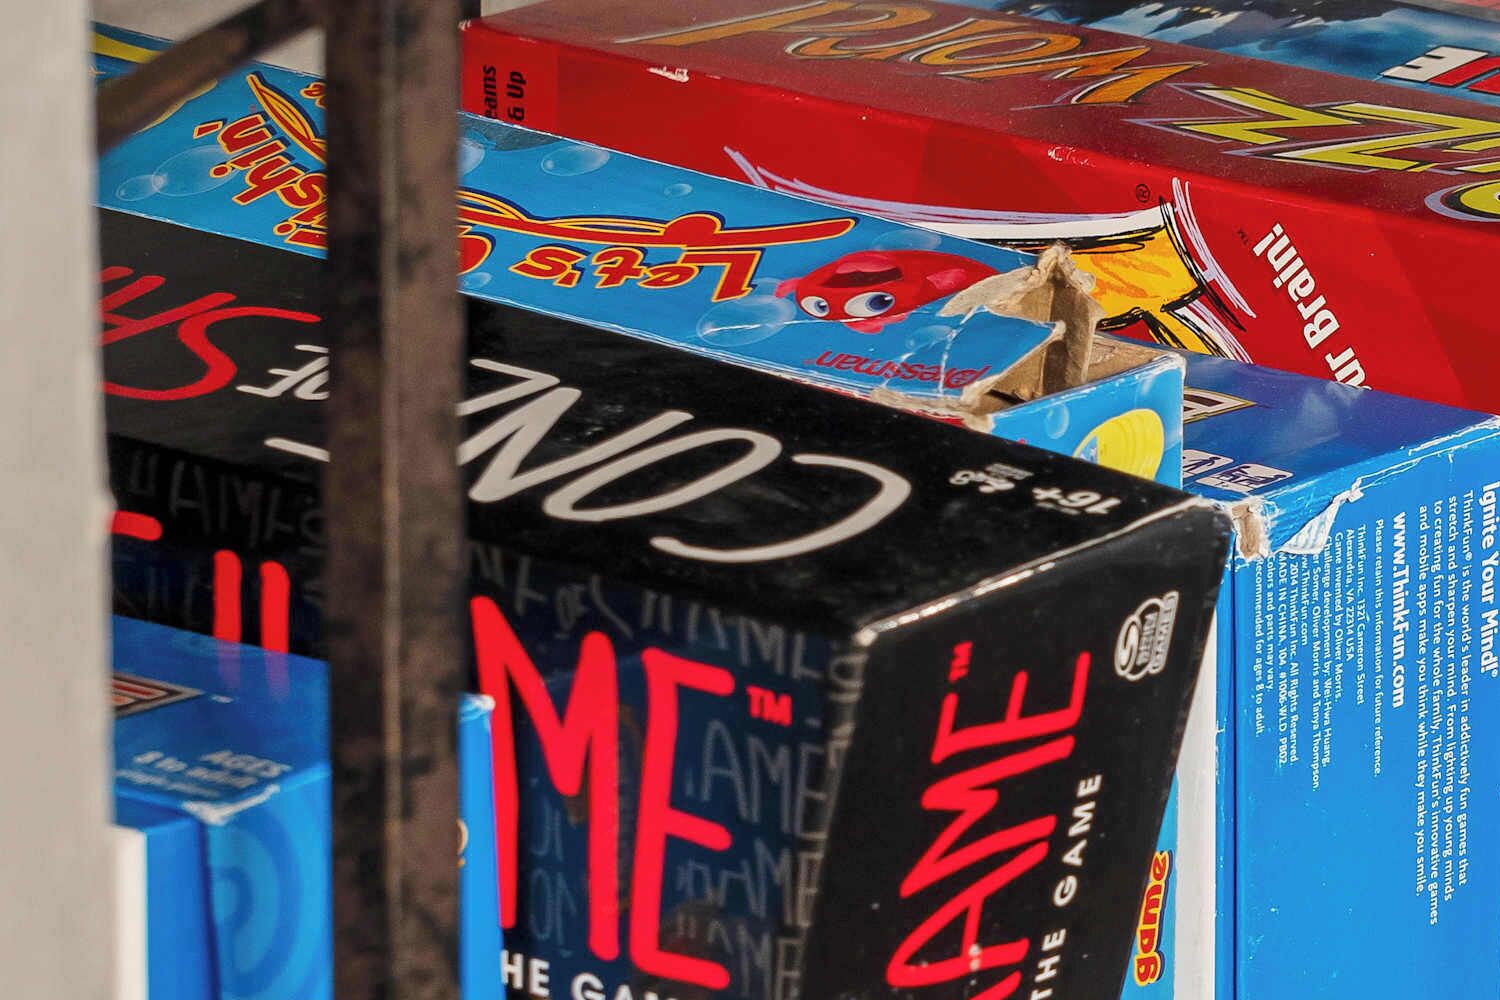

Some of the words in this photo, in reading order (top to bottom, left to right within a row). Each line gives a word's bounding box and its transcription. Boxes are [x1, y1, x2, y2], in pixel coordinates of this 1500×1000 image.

[506, 71, 526, 99] Up
[510, 245, 762, 305] Let's
[1252, 222, 1340, 349] Brain!
[814, 350, 991, 390] pressman
[1325, 347, 1372, 390] ur
[1419, 506, 1429, 530] and
[1433, 501, 1443, 515] to
[1448, 496, 1458, 541] stretch
[1479, 482, 1500, 549] Ignite
[1419, 535, 1429, 580] mobile
[1431, 518, 1442, 572] creating
[1448, 546, 1457, 570] and
[1433, 575, 1442, 597] fun
[1462, 565, 1472, 577] is
[1462, 580, 1471, 601] the
[1481, 551, 1499, 604] Your
[1392, 512, 1409, 708] www.ThinkFun.com
[1416, 584, 1427, 616] apps
[1433, 600, 1443, 620] for
[1445, 574, 1457, 627] sharpen
[1418, 620, 1428, 654] make
[1432, 623, 1442, 644] the
[1445, 630, 1455, 659] your
[1461, 605, 1471, 651] world's
[1416, 658, 1426, 682] you
[1432, 648, 1442, 687] whole
[1446, 663, 1456, 701] mind.
[1461, 656, 1471, 697] leader
[1418, 685, 1429, 719] think
[1431, 690, 1443, 733] family,
[1461, 699, 1471, 712] in
[1417, 722, 1428, 757] while
[1446, 706, 1456, 740] From
[1443, 742, 1456, 792] lighting
[1458, 717, 1470, 784] addictively
[1415, 760, 1427, 787] they
[1431, 737, 1442, 808] ThinkFun's
[1416, 791, 1427, 826] make
[1443, 797, 1454, 813] up
[1459, 788, 1470, 810] fun
[1053, 773, 1102, 907] GAME
[1414, 830, 1425, 853] you
[1430, 812, 1440, 878] innovative
[1443, 818, 1454, 857] young
[1457, 814, 1468, 856] games
[1416, 857, 1426, 896] smile.
[1444, 861, 1454, 901] minds
[1458, 859, 1469, 886] that
[1134, 849, 1174, 987] game
[1428, 882, 1439, 925] games
